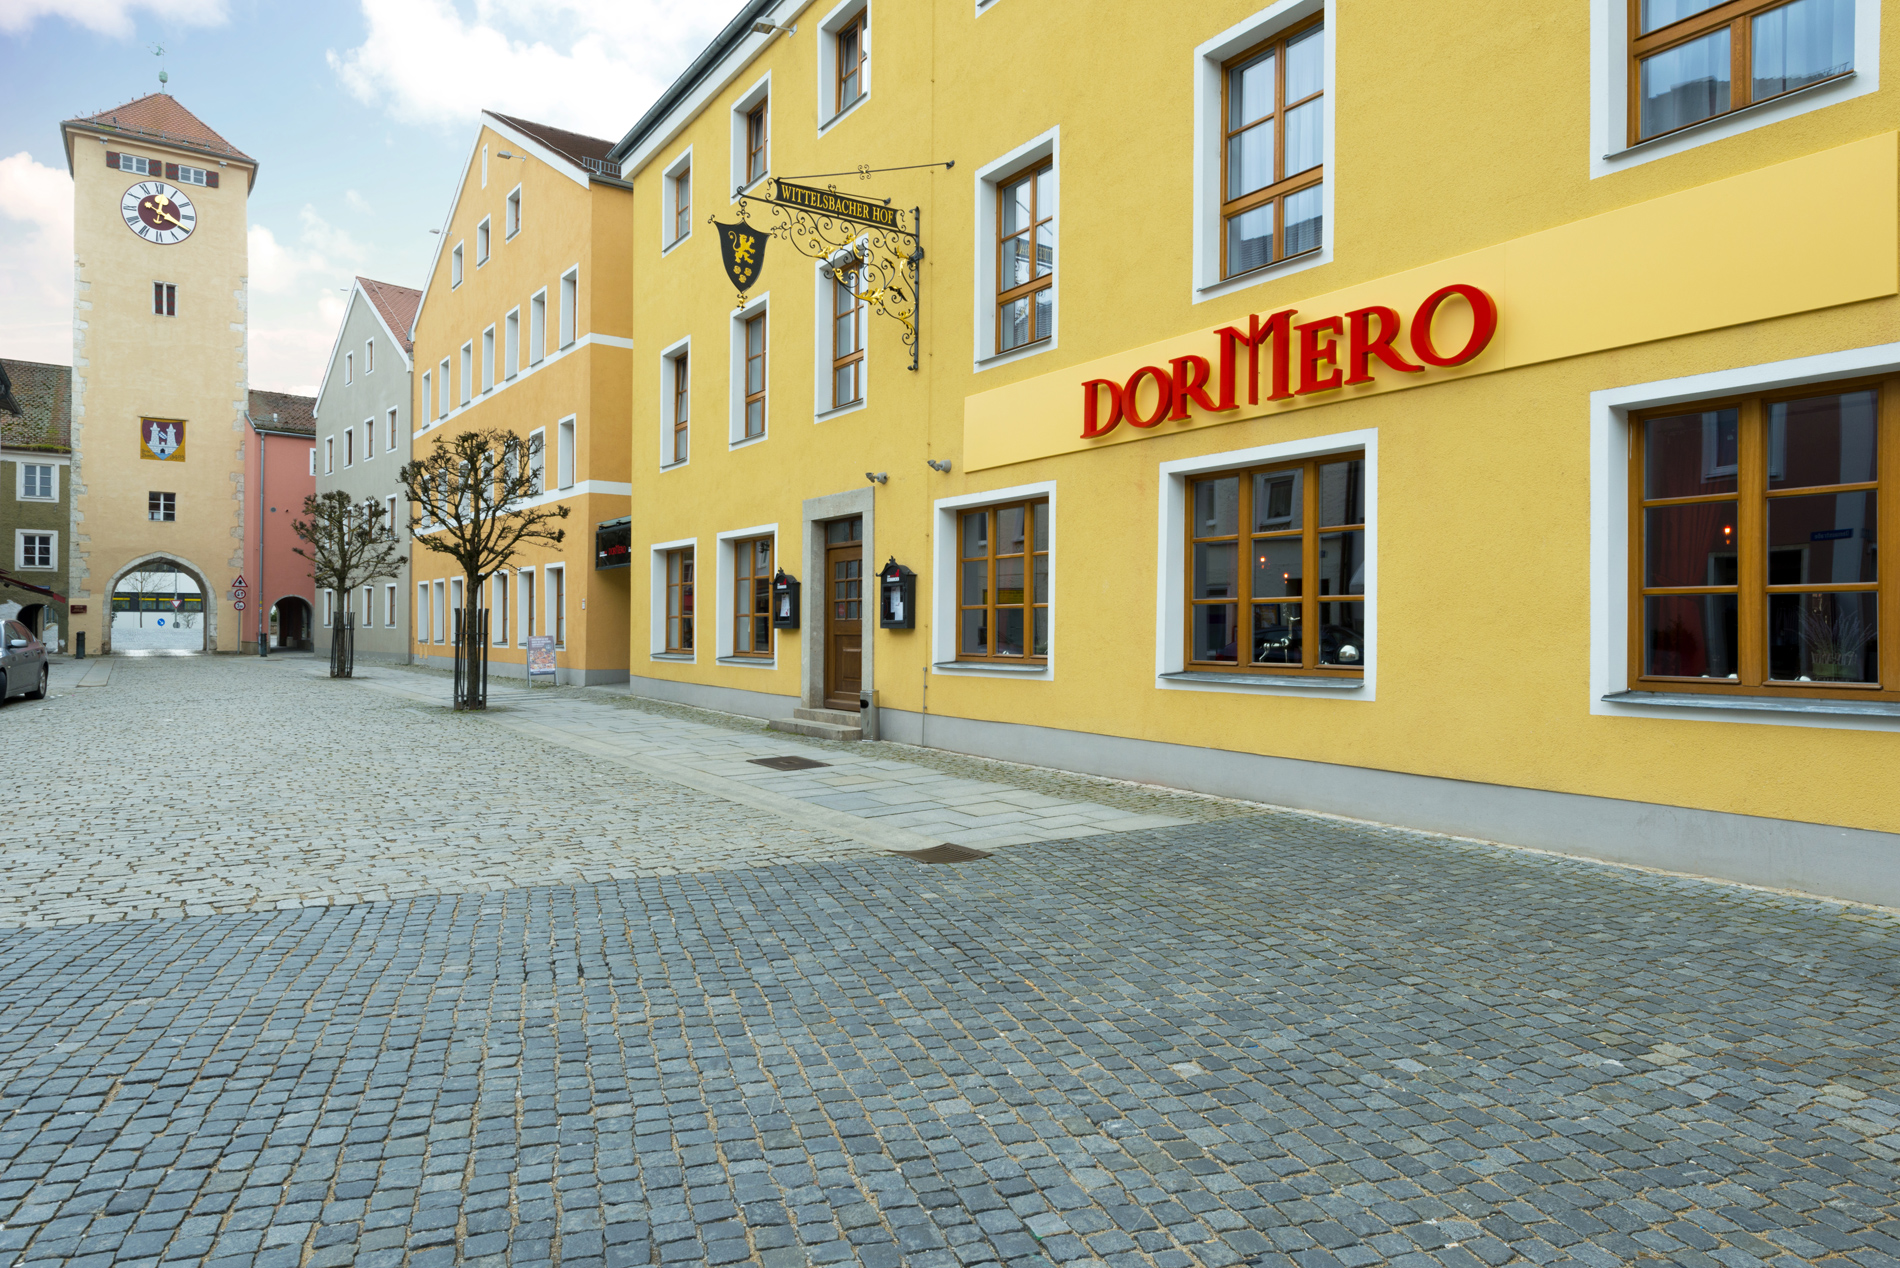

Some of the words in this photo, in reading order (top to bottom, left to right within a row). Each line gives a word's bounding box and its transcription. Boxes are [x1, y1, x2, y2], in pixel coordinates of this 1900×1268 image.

[155, 183, 164, 194] XII
[127, 191, 141, 201] X
[781, 185, 870, 218] WITTELSBACHER
[872, 207, 894, 224] HOF
[170, 231, 179, 241] V
[1080, 284, 1498, 439] DORMERO
